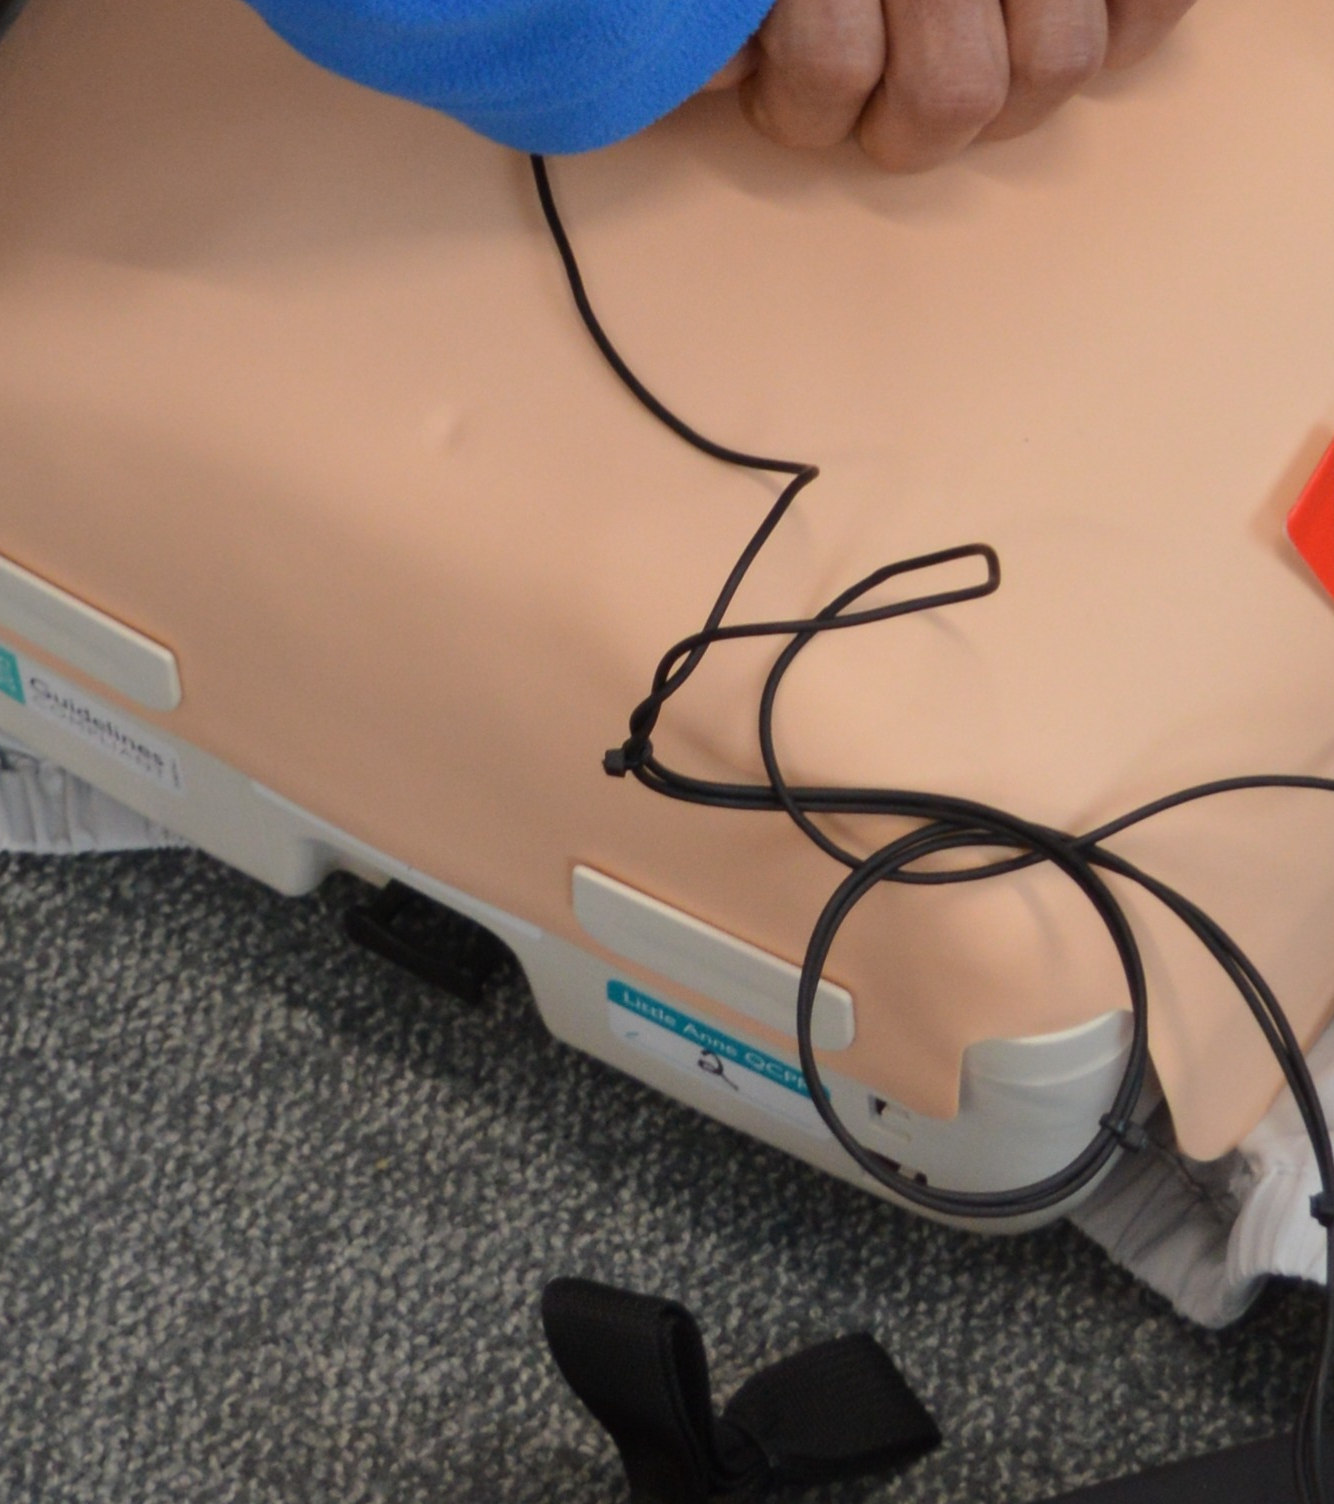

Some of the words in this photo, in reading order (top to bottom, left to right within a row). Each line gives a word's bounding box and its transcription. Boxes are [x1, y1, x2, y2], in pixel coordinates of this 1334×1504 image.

[30, 677, 164, 767] Guidelines
[623, 991, 676, 1027] Little
[683, 1023, 738, 1057] Anne
